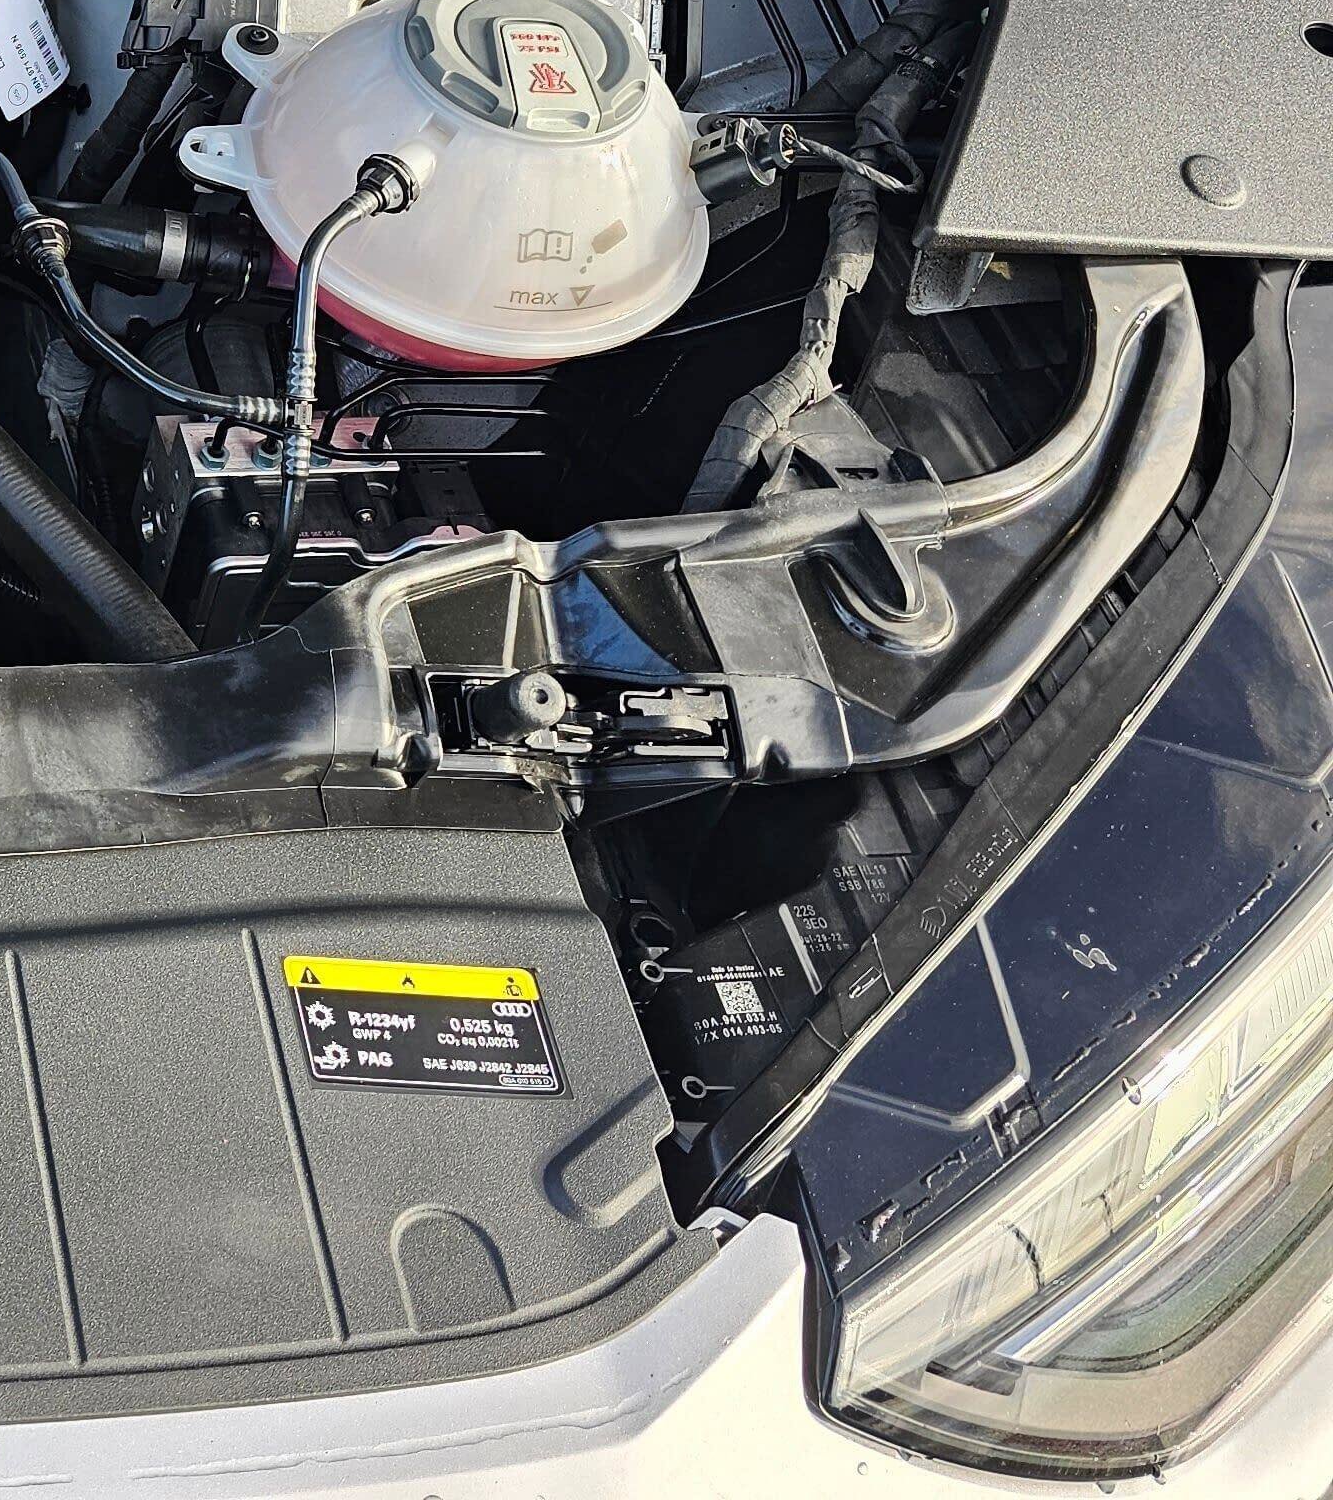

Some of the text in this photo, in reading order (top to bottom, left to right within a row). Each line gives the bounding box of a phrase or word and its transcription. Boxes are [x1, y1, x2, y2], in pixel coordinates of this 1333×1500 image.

[509, 288, 558, 306] max
[833, 866, 857, 877] SAE
[793, 905, 815, 917] 22S
[769, 967, 785, 977] AE
[347, 1010, 418, 1032] R-1234yf
[448, 1017, 515, 1038] 0,525 kg
[351, 1028, 392, 1040] GWP 4
[460, 1036, 477, 1048] eq
[356, 1051, 394, 1066] PAG
[422, 1057, 448, 1069] SAE
[477, 1060, 512, 1073] J2842
[513, 1061, 549, 1075] J2845
